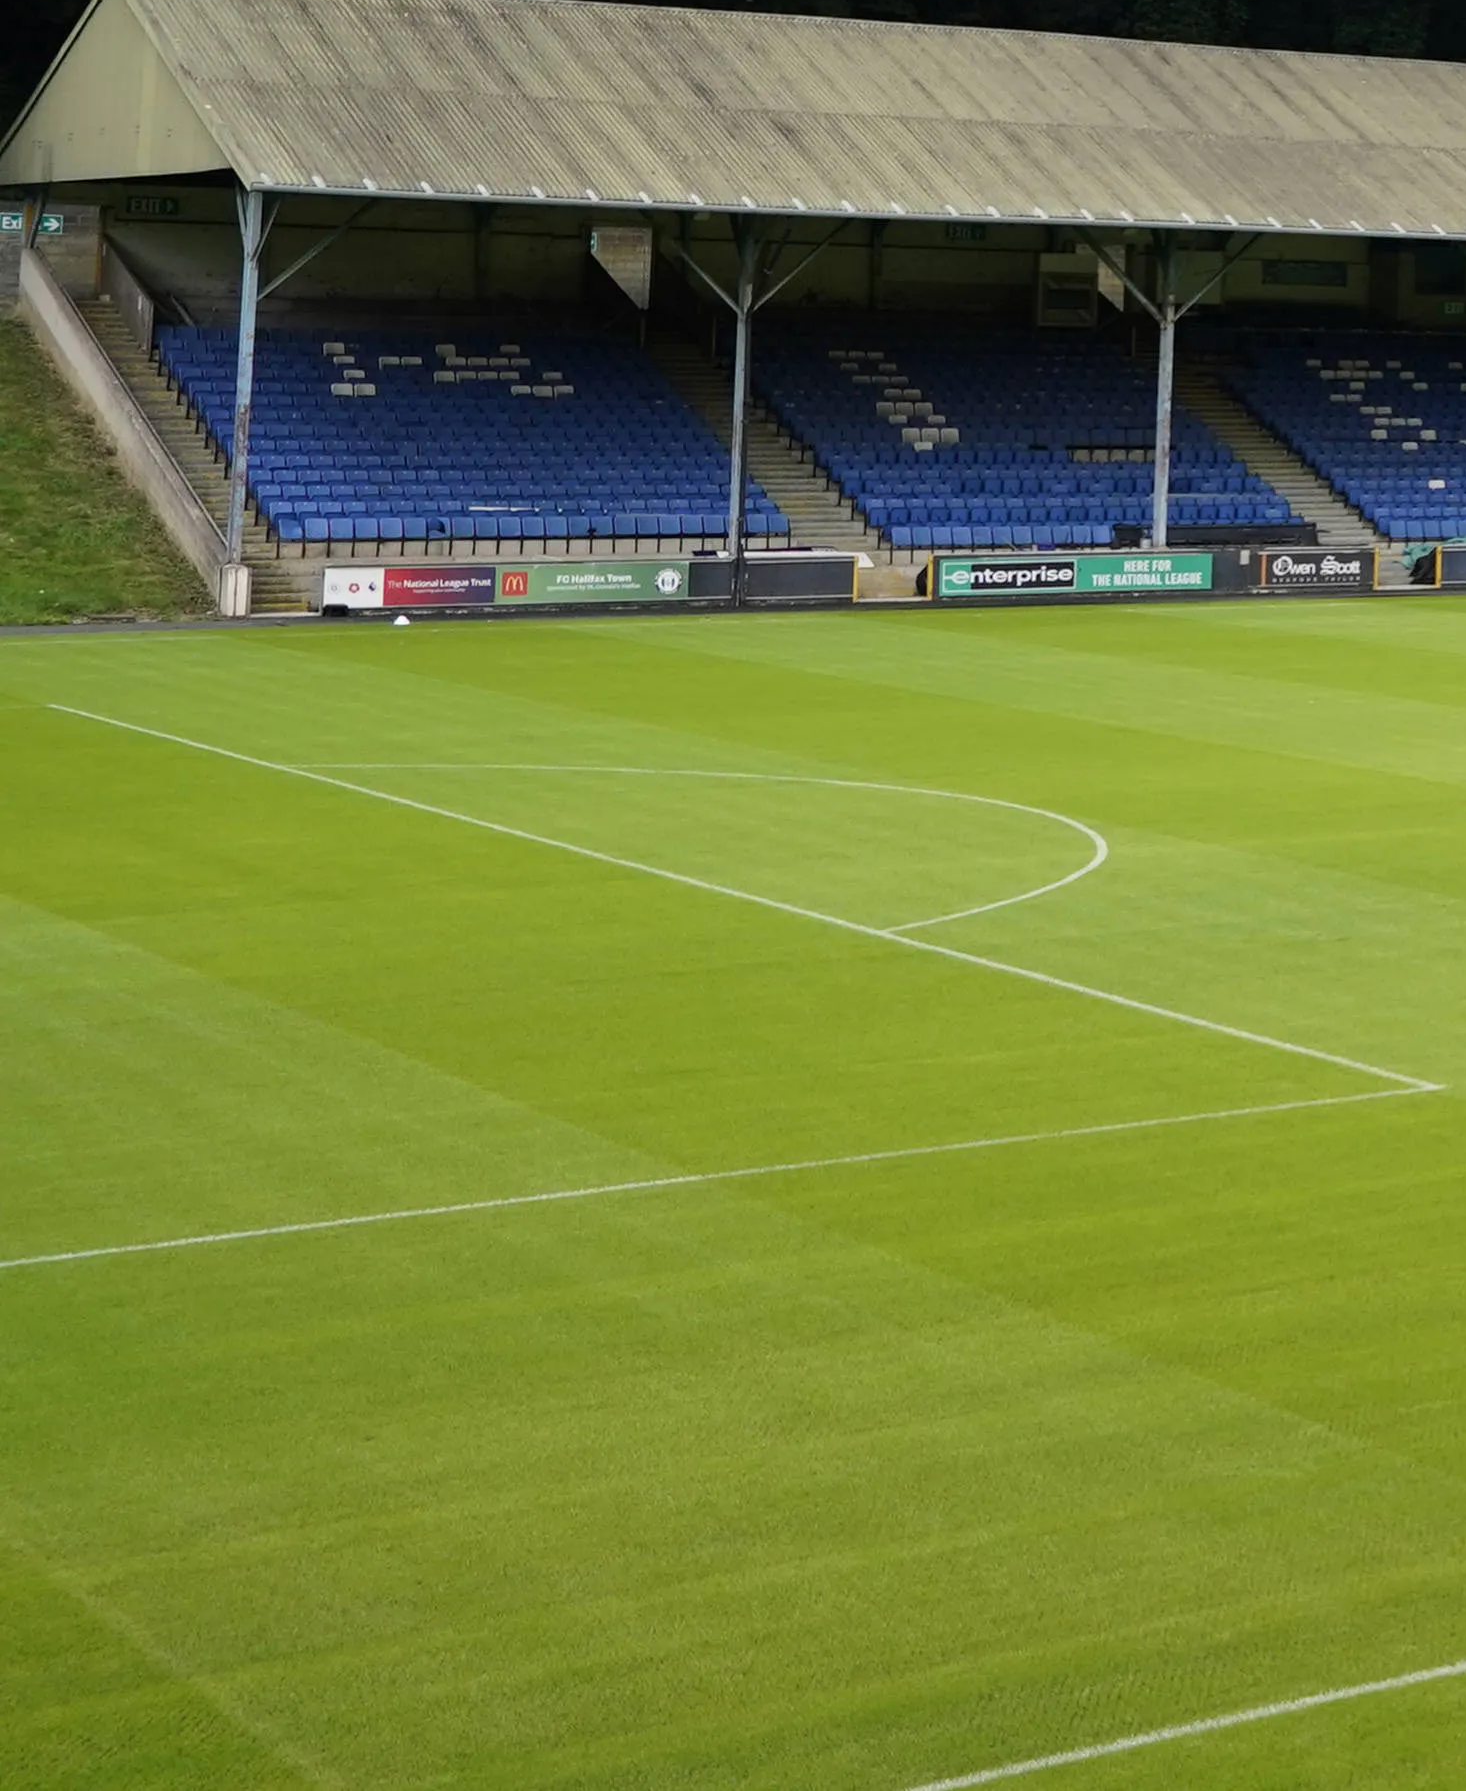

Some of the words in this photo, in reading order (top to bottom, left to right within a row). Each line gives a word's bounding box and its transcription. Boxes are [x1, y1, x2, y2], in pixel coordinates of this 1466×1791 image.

[131, 198, 161, 213] EXIT
[2, 216, 23, 229] Exi
[1124, 560, 1149, 572] HERE
[1152, 560, 1172, 571] FOR
[1272, 555, 1316, 576] Owen
[1319, 555, 1361, 575] Scott
[556, 575, 570, 584] FC
[571, 574, 606, 584] Halifax
[607, 573, 632, 583] Town
[951, 565, 1073, 586] enterprise
[1092, 574, 1111, 587] THE
[1113, 573, 1161, 586] NATIONAL
[1164, 572, 1203, 585] LEAGUE
[403, 578, 439, 588] National
[440, 578, 469, 589] League
[470, 578, 491, 587] Trust
